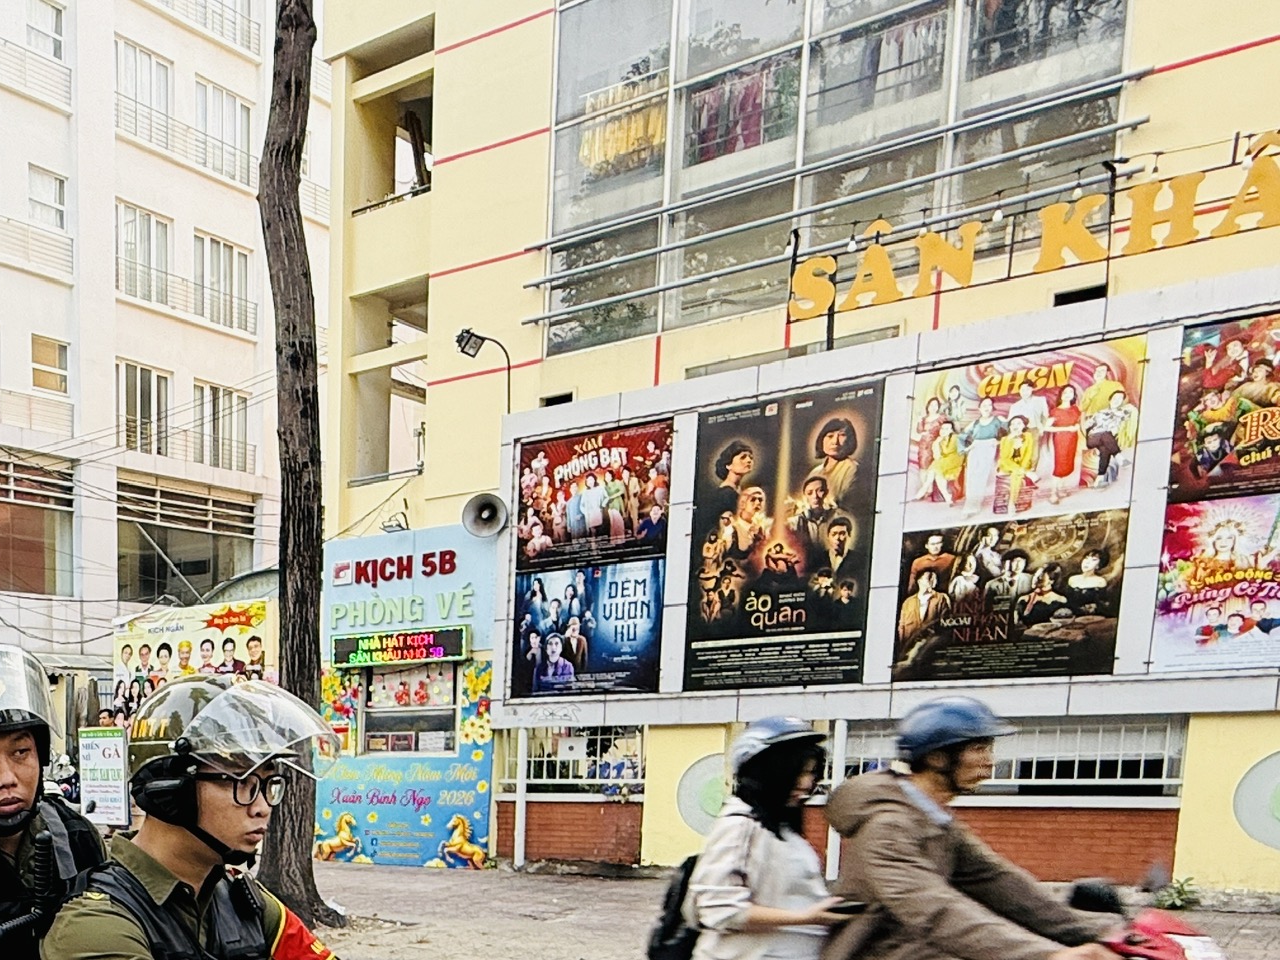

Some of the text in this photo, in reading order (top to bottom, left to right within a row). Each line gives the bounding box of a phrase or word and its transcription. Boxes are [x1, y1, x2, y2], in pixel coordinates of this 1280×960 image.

[789, 219, 983, 320] SÂN
[977, 361, 1075, 398] GHEN
[354, 550, 457, 588] KỊCH 5B
[330, 582, 474, 629] PHÒNG VÉ
[751, 606, 806, 630] quan
[101, 743, 121, 759] GÀ
